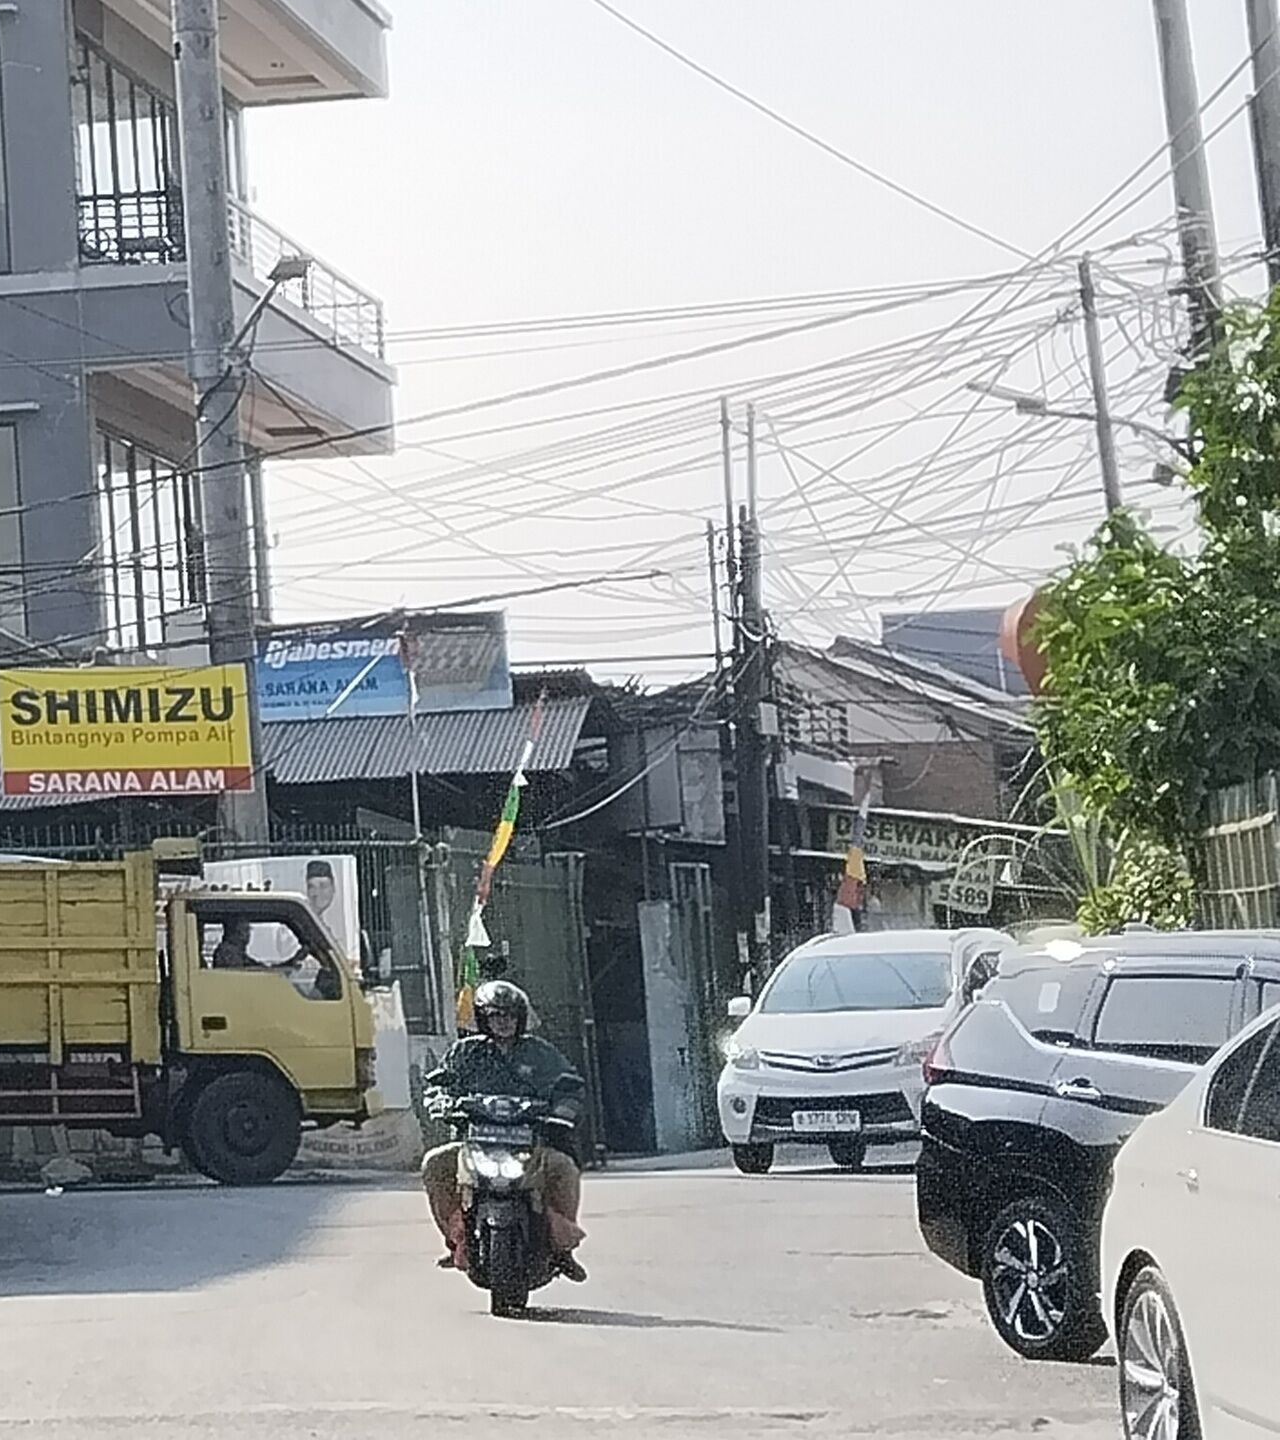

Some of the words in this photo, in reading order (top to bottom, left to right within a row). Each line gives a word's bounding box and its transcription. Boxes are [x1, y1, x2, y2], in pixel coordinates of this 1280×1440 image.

[10, 686, 234, 726] SHIMIZU
[11, 728, 125, 748] Bintangnya
[132, 727, 200, 746] Pompa
[205, 725, 236, 743] Air
[28, 769, 142, 793] SARANA
[150, 768, 225, 791] ALAM
